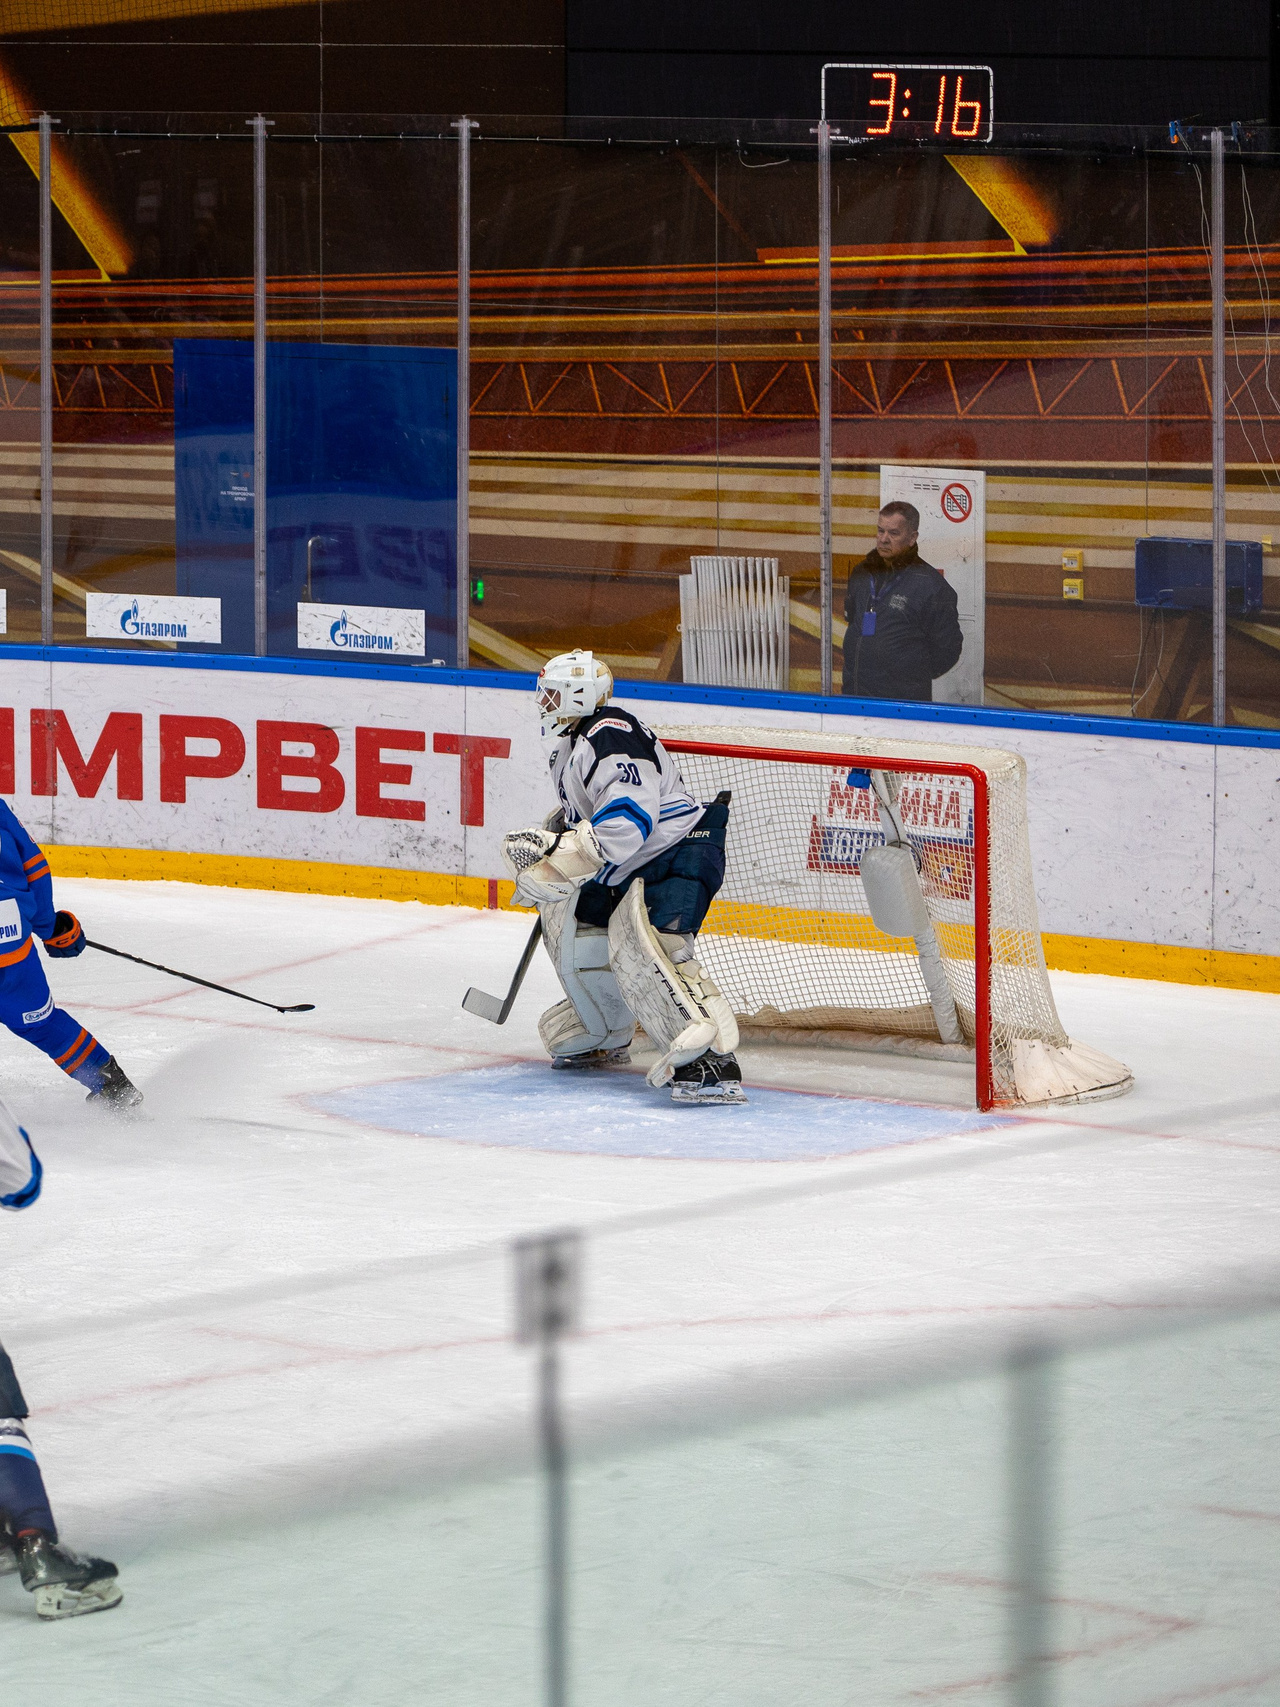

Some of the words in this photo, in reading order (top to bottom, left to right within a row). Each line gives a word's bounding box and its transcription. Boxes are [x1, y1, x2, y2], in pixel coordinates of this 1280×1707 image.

[866, 73, 981, 136] 3:16
[616, 762, 643, 787] 30
[827, 780, 961, 829] МАИНА
[685, 830, 711, 839] UER
[653, 962, 692, 1021] TRUE
